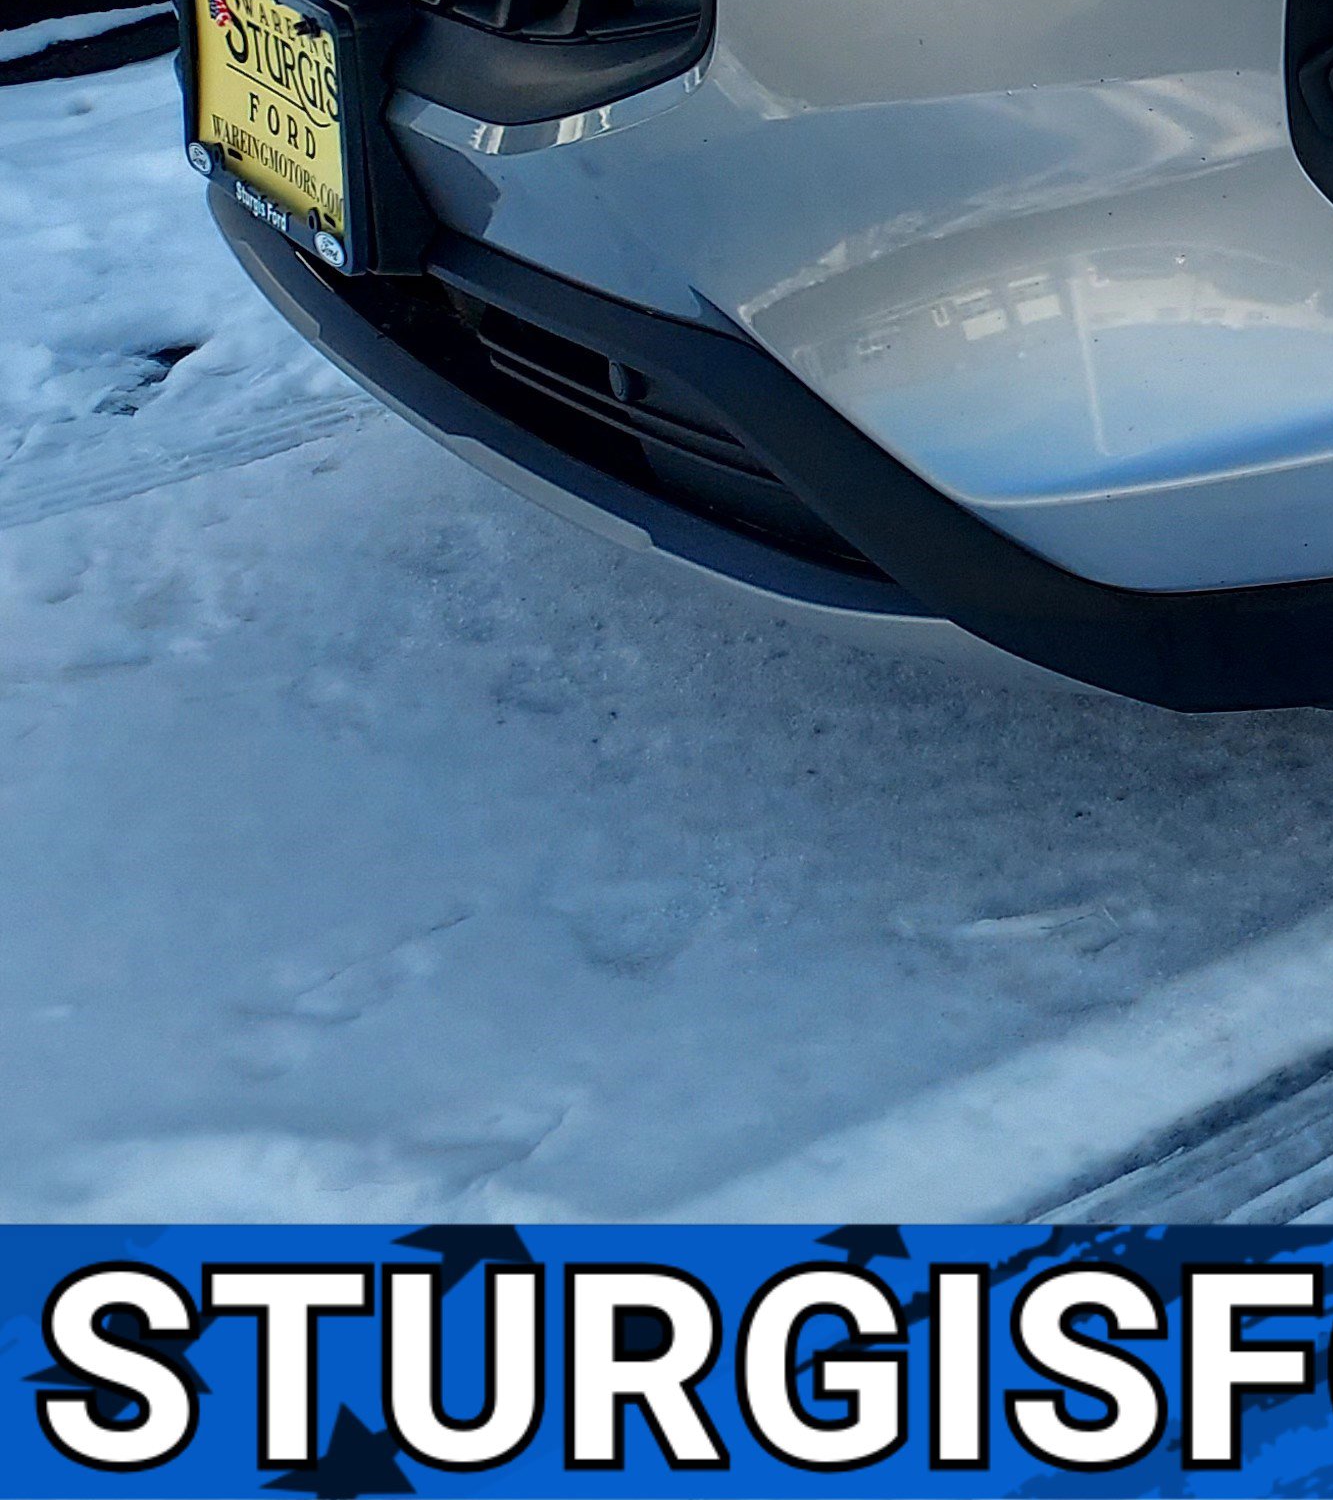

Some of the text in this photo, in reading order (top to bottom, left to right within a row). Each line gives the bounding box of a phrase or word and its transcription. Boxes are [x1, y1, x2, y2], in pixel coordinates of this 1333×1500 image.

[249, 91, 317, 161] FORD
[211, 113, 345, 223] WAREINGMOTORS.COM
[235, 181, 288, 233] Sturgis Ford
